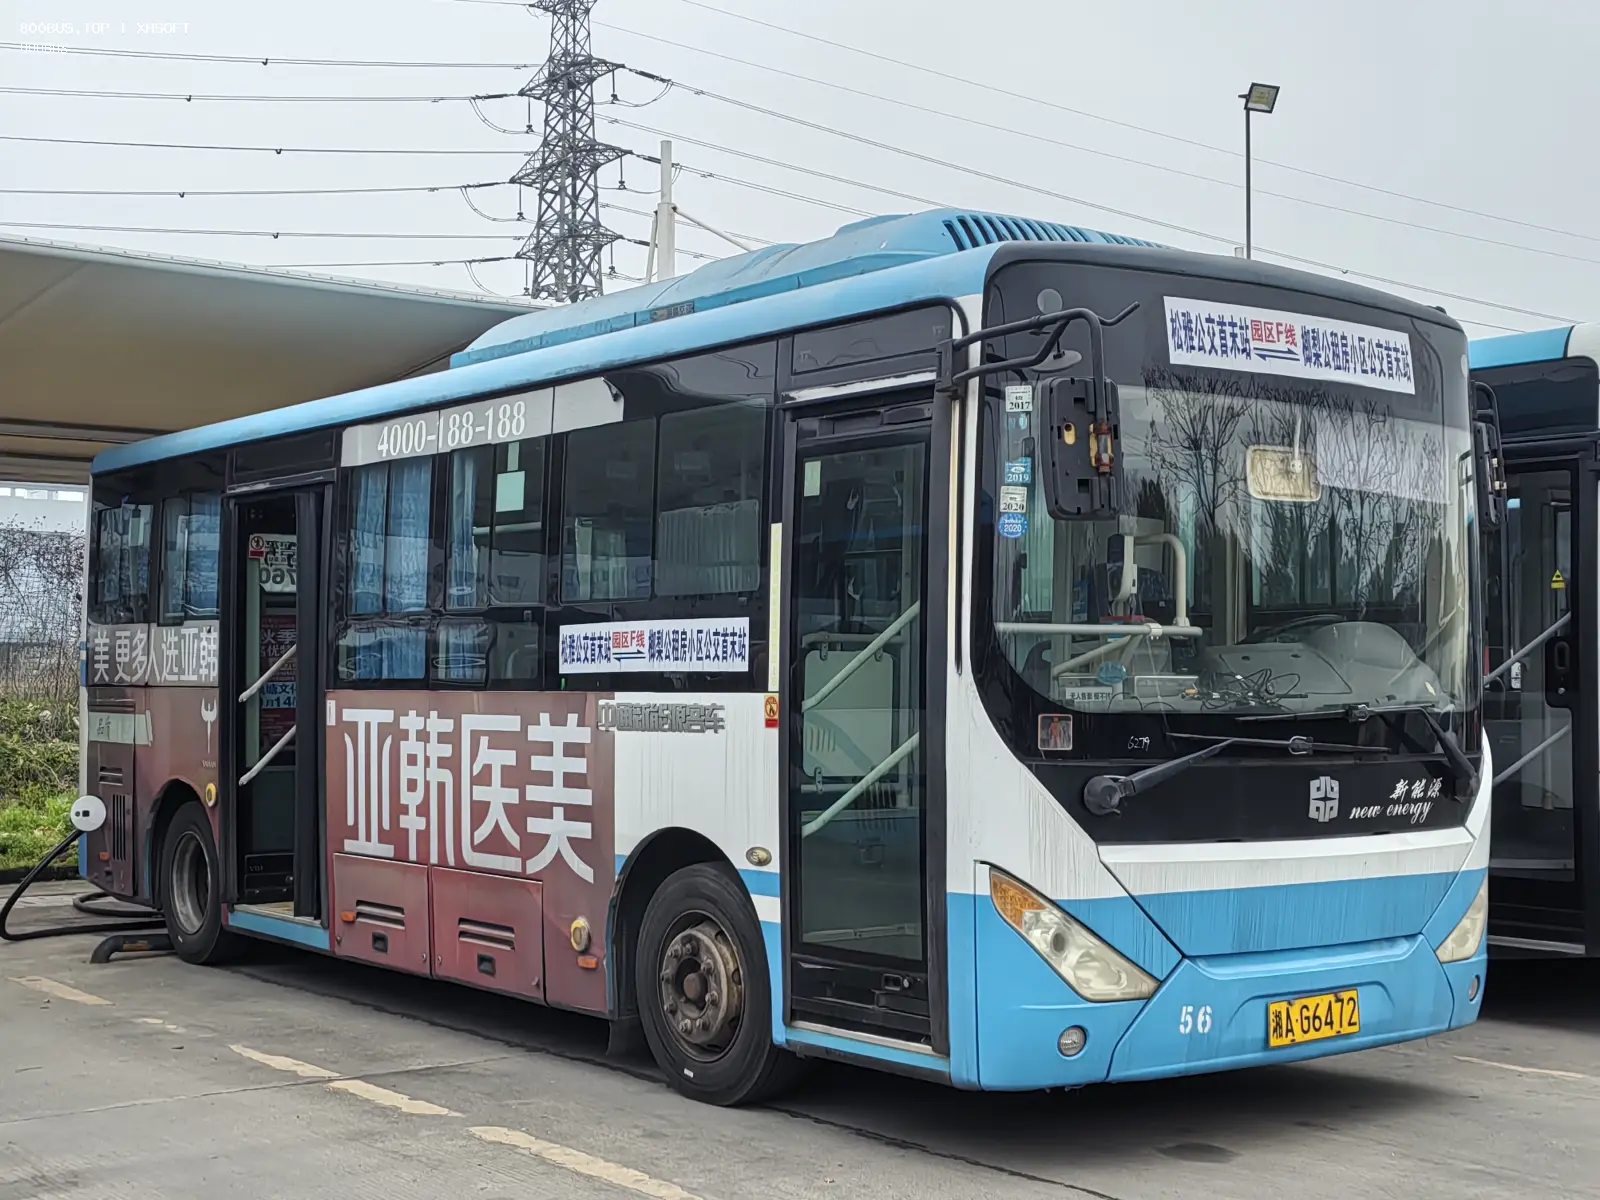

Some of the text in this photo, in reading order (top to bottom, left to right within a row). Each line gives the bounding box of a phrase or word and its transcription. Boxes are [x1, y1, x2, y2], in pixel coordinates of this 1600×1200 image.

[1170, 308, 1252, 360] 松雅公交首末站
[1250, 319, 1297, 347] 园区F线
[1009, 401, 1030, 410] 2017
[377, 400, 526, 458] 4000-188-188
[1007, 474, 1029, 482] 2019
[1002, 502, 1025, 511] 2020
[1004, 524, 1022, 533] 2020
[561, 630, 611, 665] 松雅公交首末站
[612, 630, 646, 649] 园区F线
[1127, 735, 1150, 752] 6279
[342, 708, 594, 884] 亚韩医美
[1389, 777, 1443, 802] 新能源
[1349, 801, 1434, 824] new energy
[1179, 1005, 1213, 1035] 56
